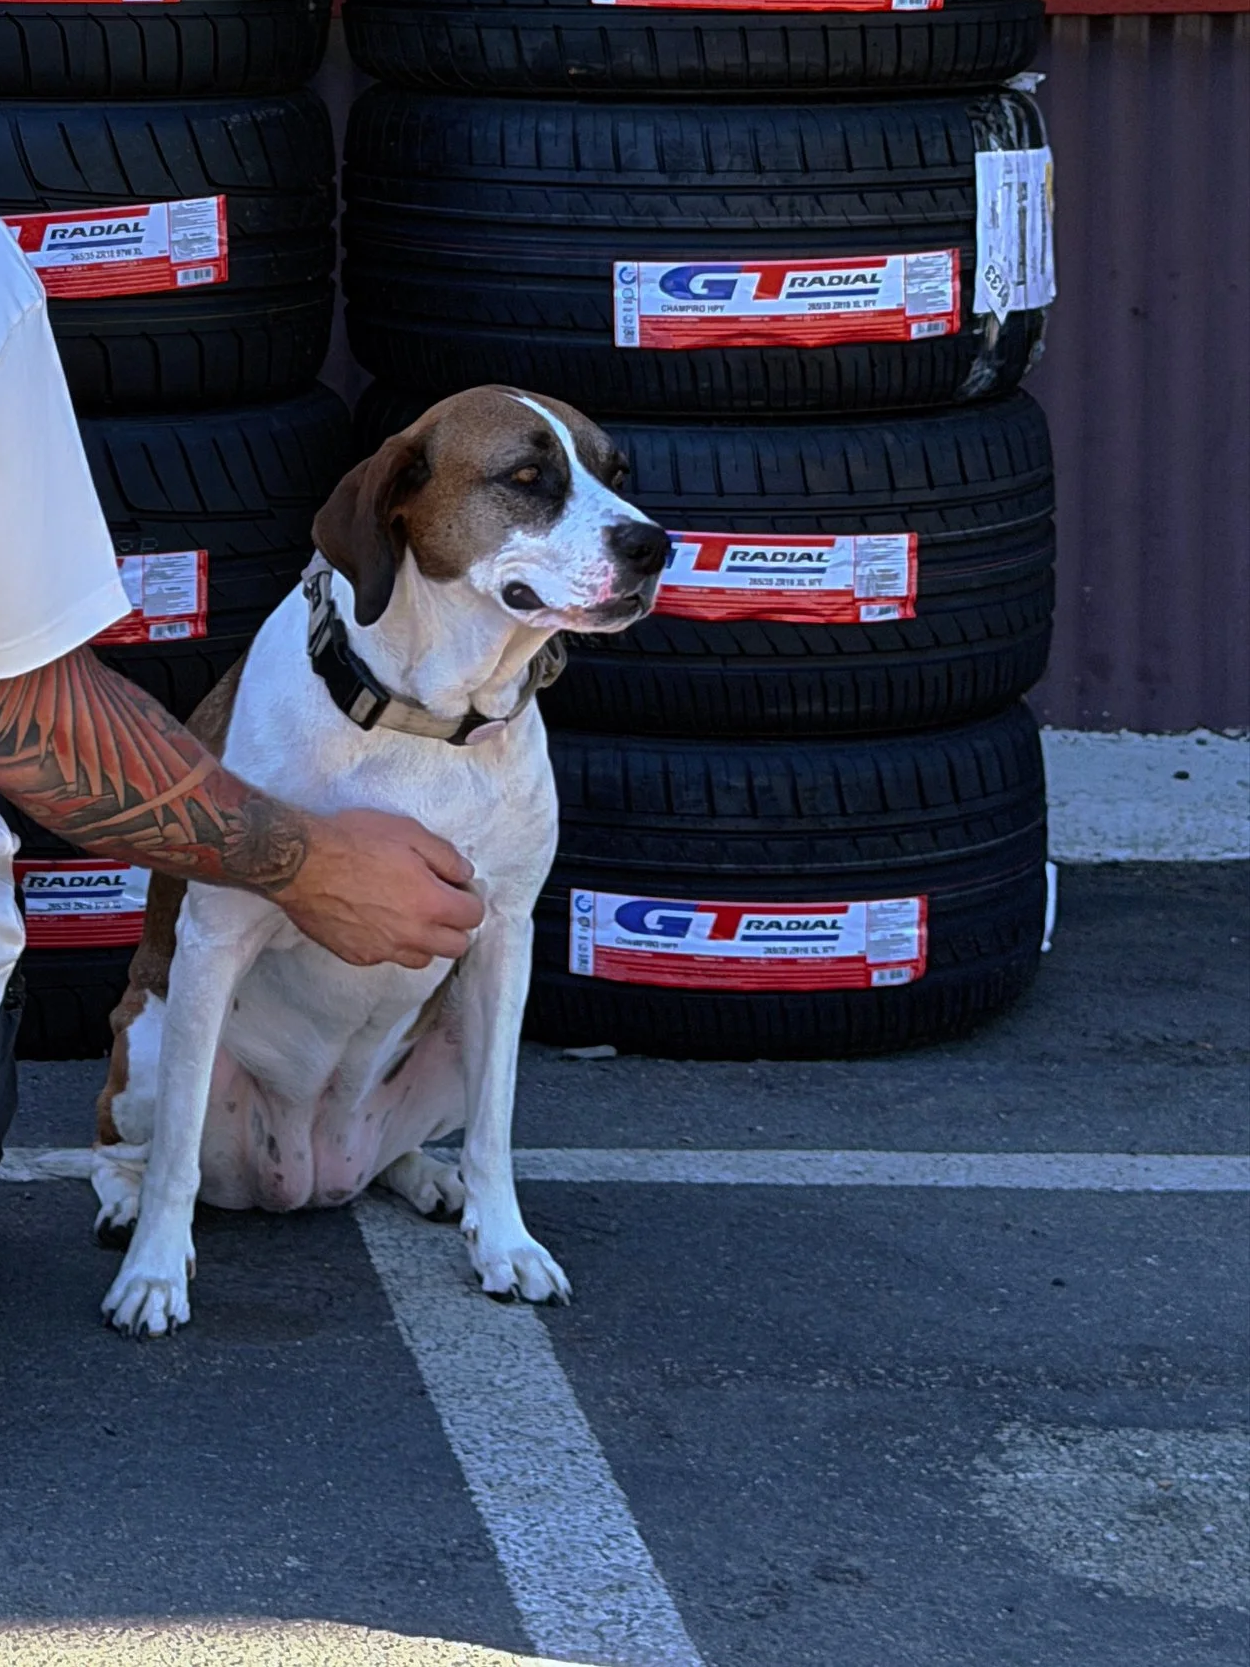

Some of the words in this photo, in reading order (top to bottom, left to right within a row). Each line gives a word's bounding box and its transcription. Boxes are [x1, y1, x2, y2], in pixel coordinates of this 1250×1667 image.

[50, 222, 146, 239] RADIAL
[789, 272, 882, 288] RADIAL
[661, 304, 706, 314] CHAMPIRO
[729, 550, 831, 563] RADIAL
[28, 875, 127, 888] RADIAL
[744, 919, 843, 931] RADIAL
